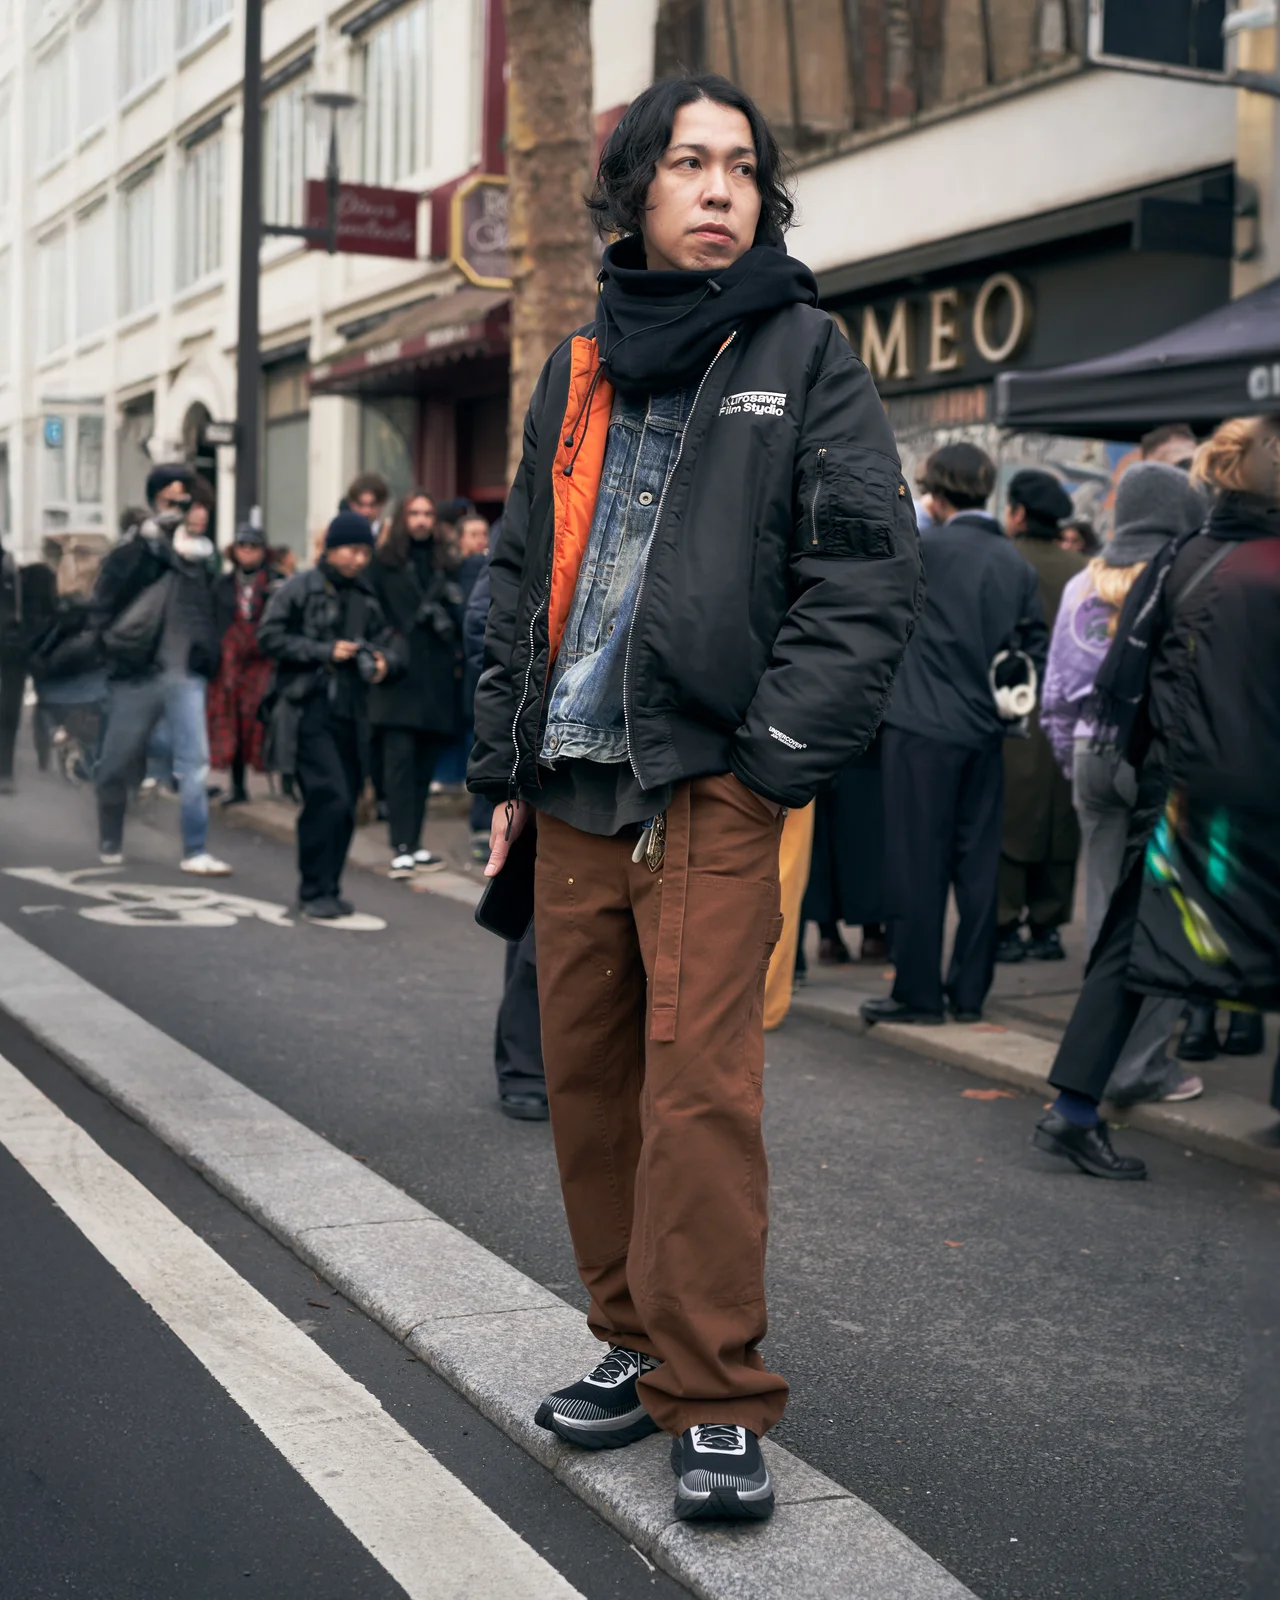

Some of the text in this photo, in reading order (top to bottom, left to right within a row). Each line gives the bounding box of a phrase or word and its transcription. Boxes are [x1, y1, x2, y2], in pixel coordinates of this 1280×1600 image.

[832, 272, 1026, 380] MEO
[721, 393, 787, 407] Kurosawa
[718, 402, 785, 417] Film Studio
